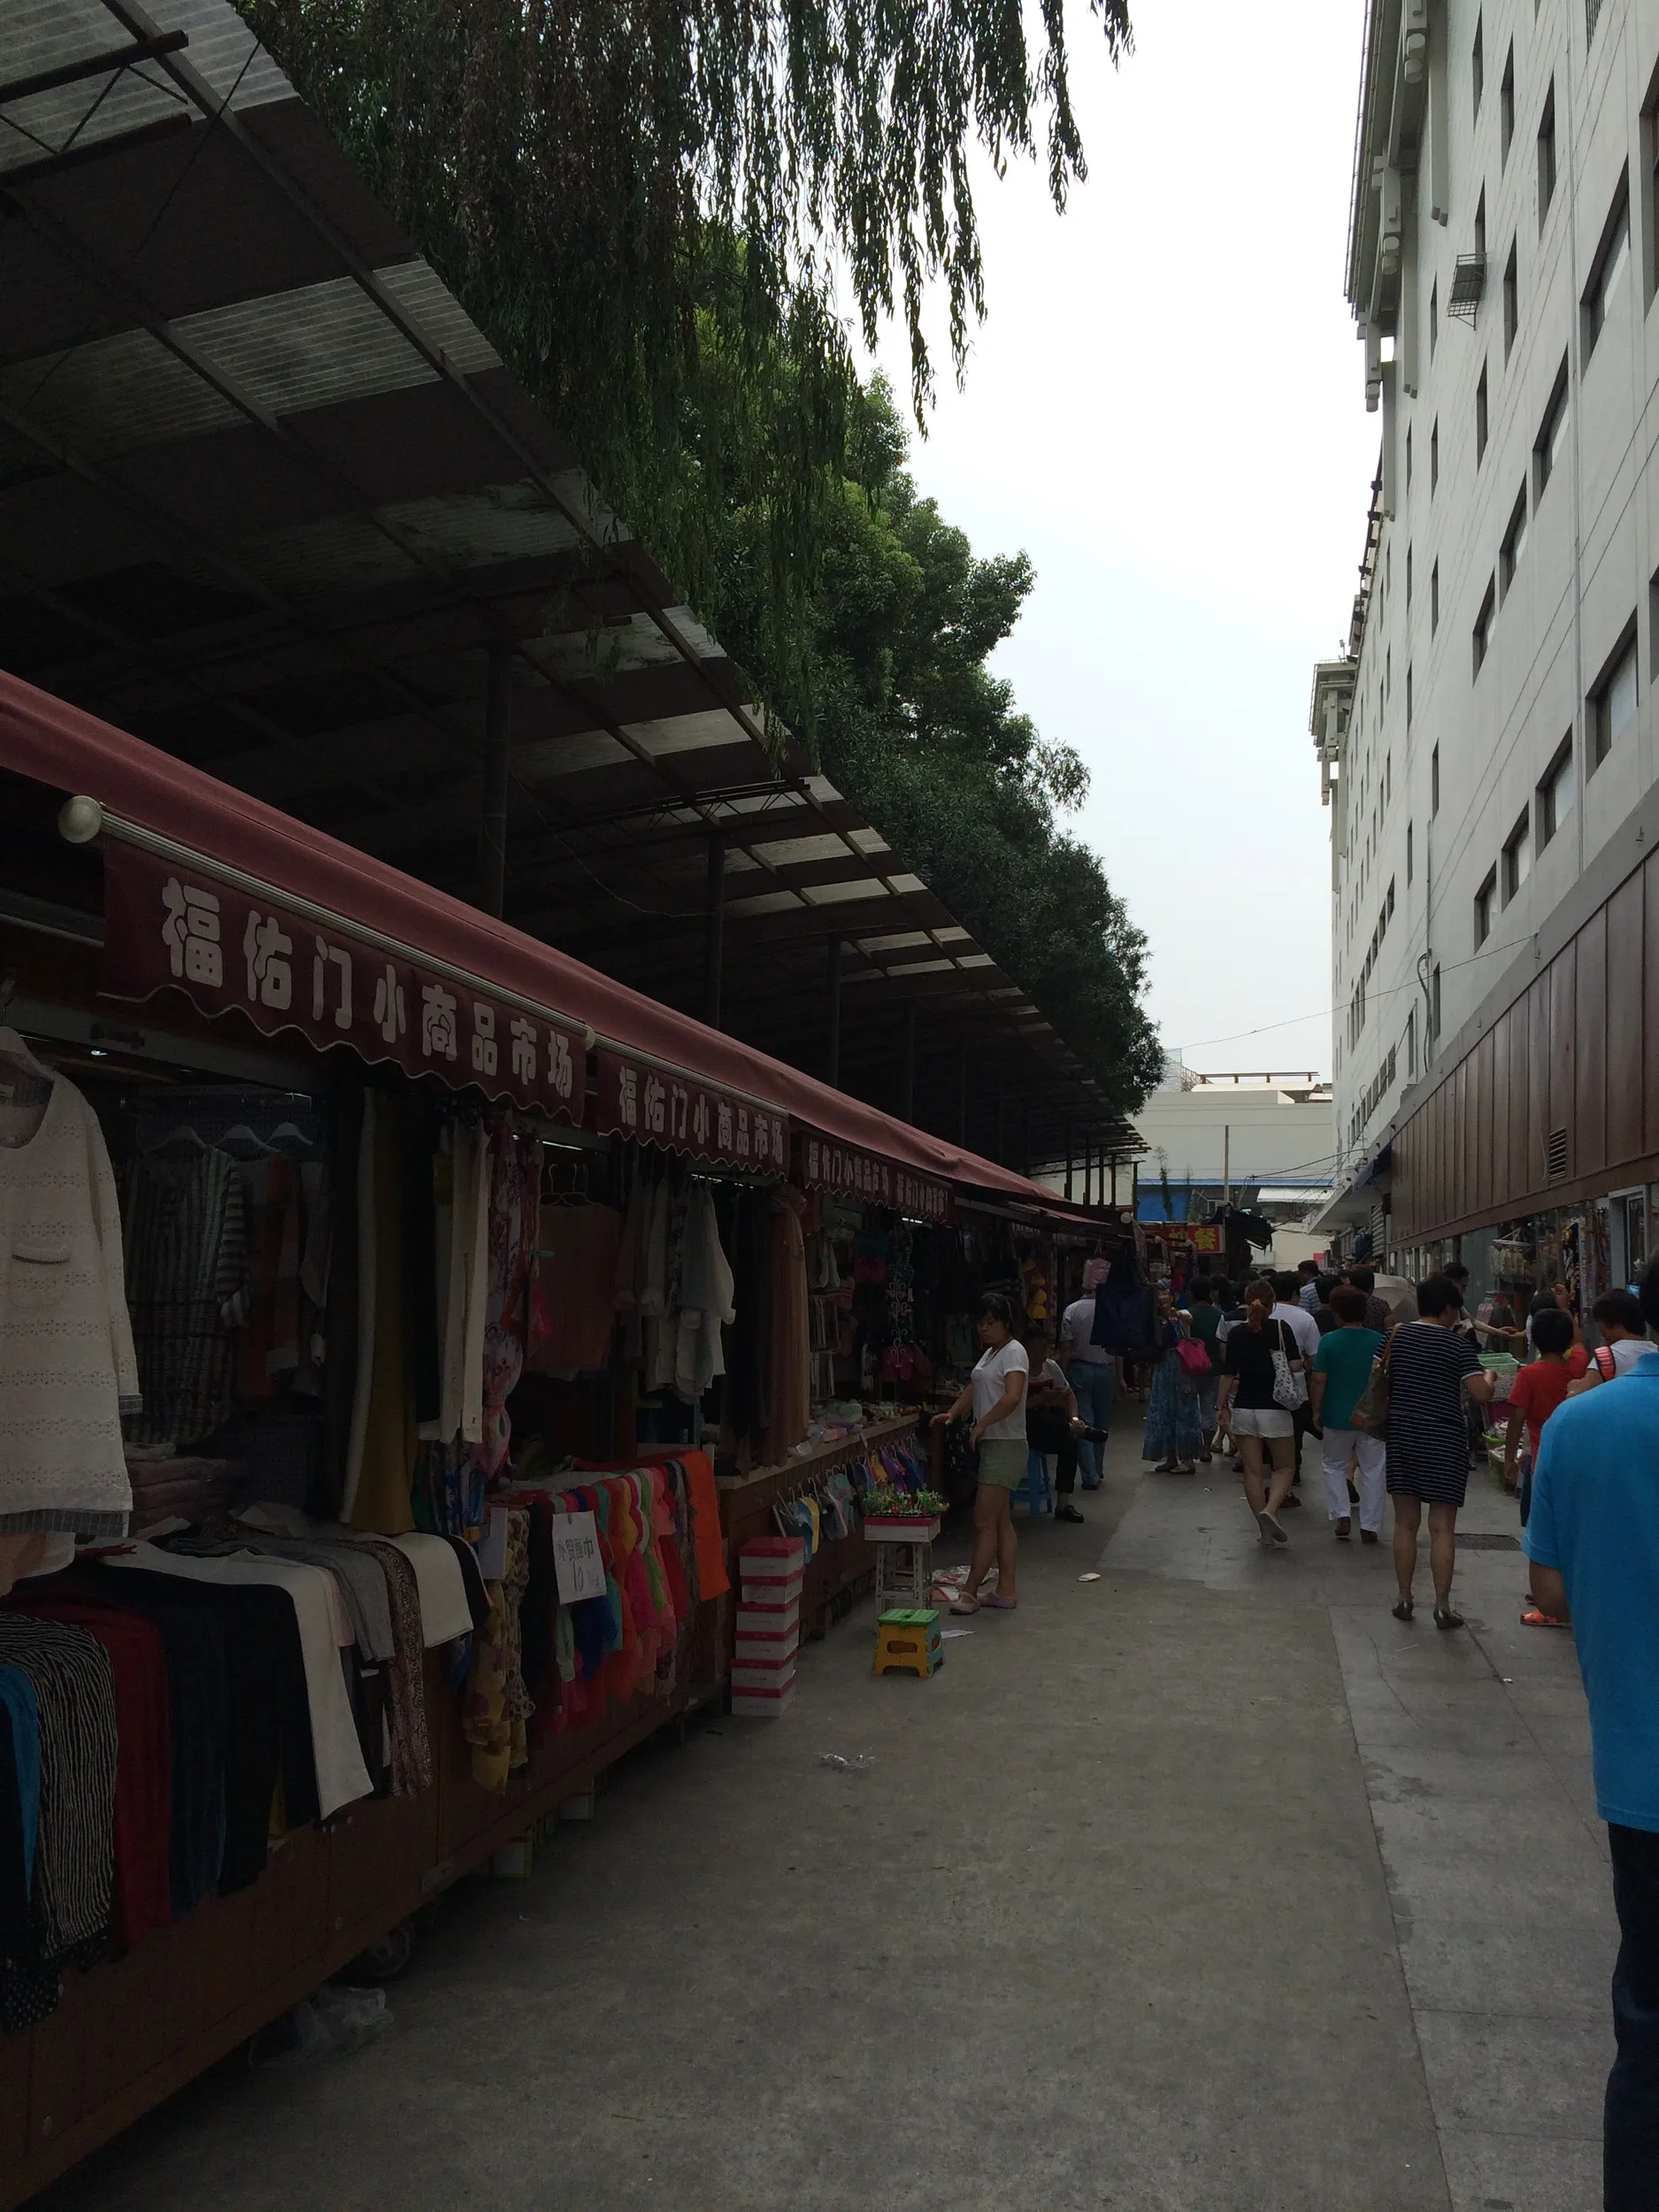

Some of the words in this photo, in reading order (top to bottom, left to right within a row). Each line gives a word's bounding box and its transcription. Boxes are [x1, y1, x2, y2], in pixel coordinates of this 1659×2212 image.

[162, 877, 573, 1098] 福佑门小商品市场
[619, 1065, 784, 1164] 福佑门小商品市场
